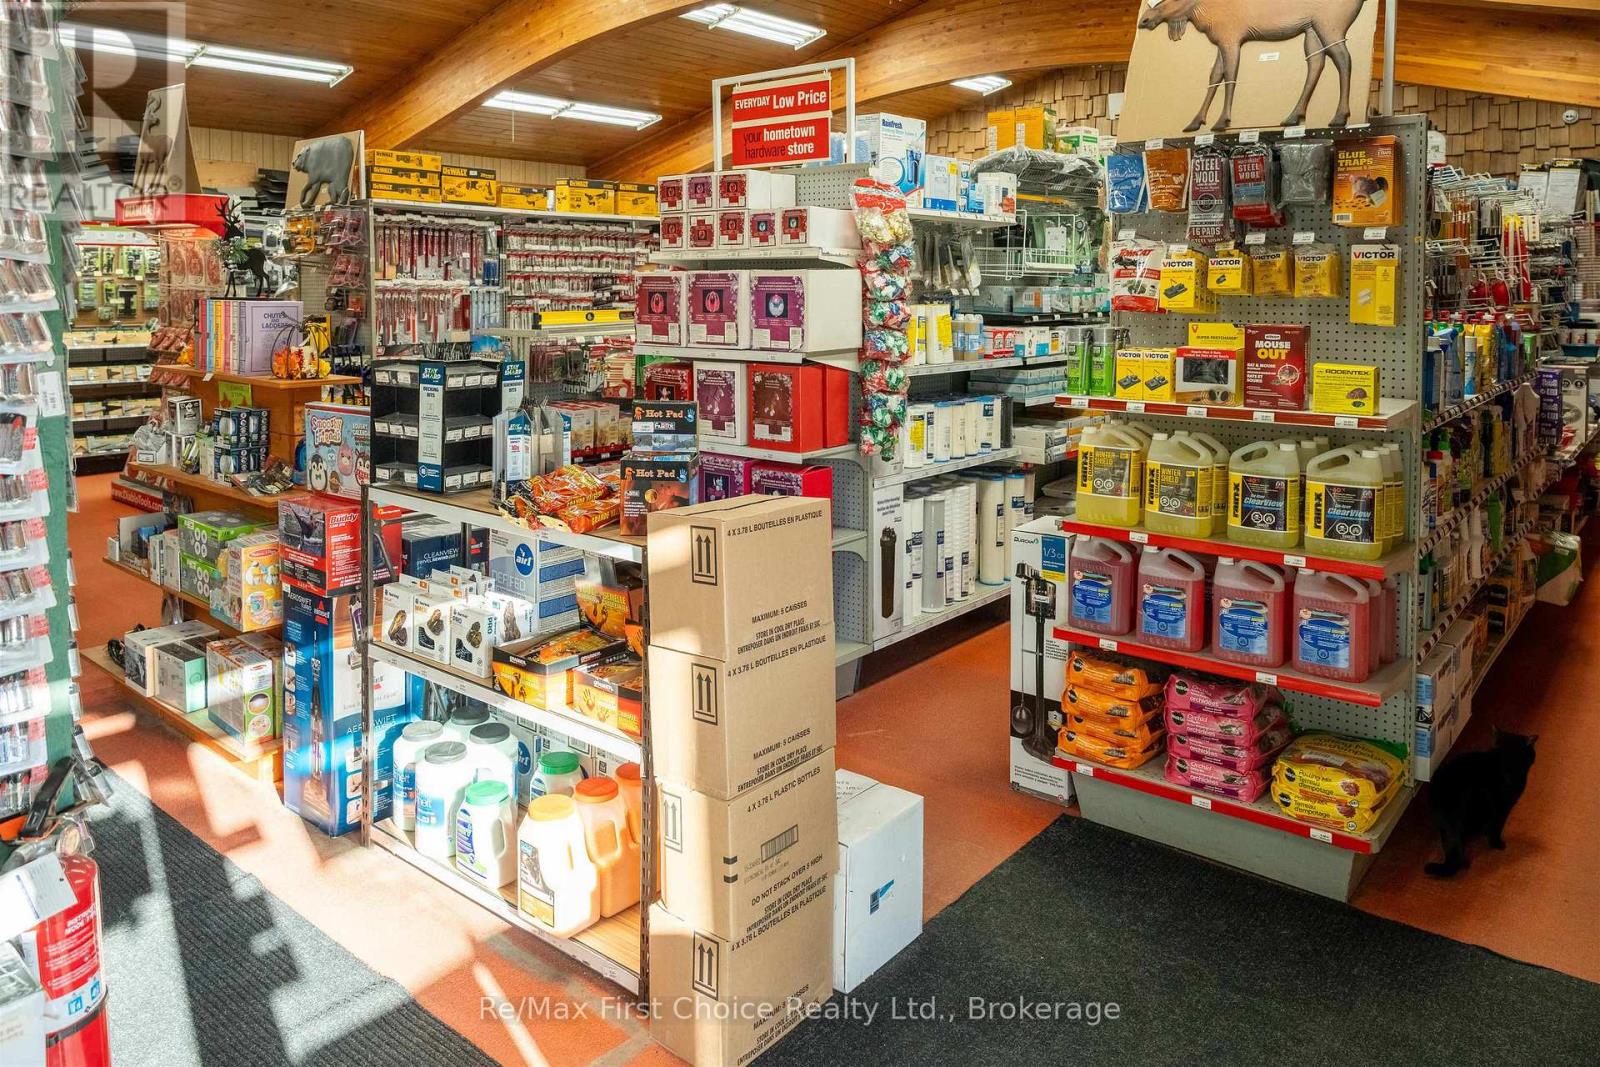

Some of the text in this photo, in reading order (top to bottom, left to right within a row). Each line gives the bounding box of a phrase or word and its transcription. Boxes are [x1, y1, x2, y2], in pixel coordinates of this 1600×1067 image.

[735, 89, 826, 110] EVERYDAY Low Price
[744, 126, 815, 144] your hometown
[745, 142, 814, 160] hardware store
[1338, 151, 1366, 159] GLUE
[1195, 158, 1220, 170] STEEL
[1338, 158, 1373, 166] TRAPS
[1195, 171, 1220, 183] WOOL
[1202, 227, 1220, 235] PADS
[1257, 349, 1288, 360] OUT
[645, 409, 684, 418] Hot Pad
[635, 468, 676, 478] Hot Pad
[1161, 468, 1181, 477] WINTER
[1161, 476, 1178, 484] SHIELD
[1244, 497, 1284, 508] ClearView
[1328, 508, 1372, 518] ClearView
[737, 526, 748, 534] 3.78
[754, 518, 787, 532] BOUTEILLES
[787, 517, 794, 525] EN
[795, 510, 822, 523] PLASTIQUE
[424, 548, 459, 560] CLEANVIEW
[752, 609, 779, 624] MAXIMUM:
[785, 600, 807, 613] CAISSES
[738, 641, 763, 654] ENTREPOSER
[738, 664, 749, 673] 3.78
[755, 650, 789, 668] BOUTEILLES
[790, 646, 797, 655] EN
[798, 635, 826, 652] PLASTIQUE
[1187, 714, 1208, 722] Orchid
[753, 742, 783, 760] MAXIMUM:
[788, 728, 810, 744] CAISSES
[757, 764, 770, 775] STORE
[776, 756, 786, 768] COOL
[1191, 762, 1212, 770] Orchid
[738, 776, 764, 792] ENTREPOSER
[752, 802, 756, 810] X
[757, 796, 769, 808] 3.78
[769, 793, 773, 802] L
[774, 779, 796, 798] PLASTIC
[797, 766, 821, 785] BOTTLES
[752, 895, 760, 906] DO
[761, 889, 773, 901] NOT
[774, 877, 790, 893] STACK
[792, 866, 806, 882] OVER
[810, 854, 823, 868] HIGH
[758, 911, 790, 935] BOUTEILLES
[792, 905, 799, 915] EN
[800, 886, 826, 909] PLASTIQUE
